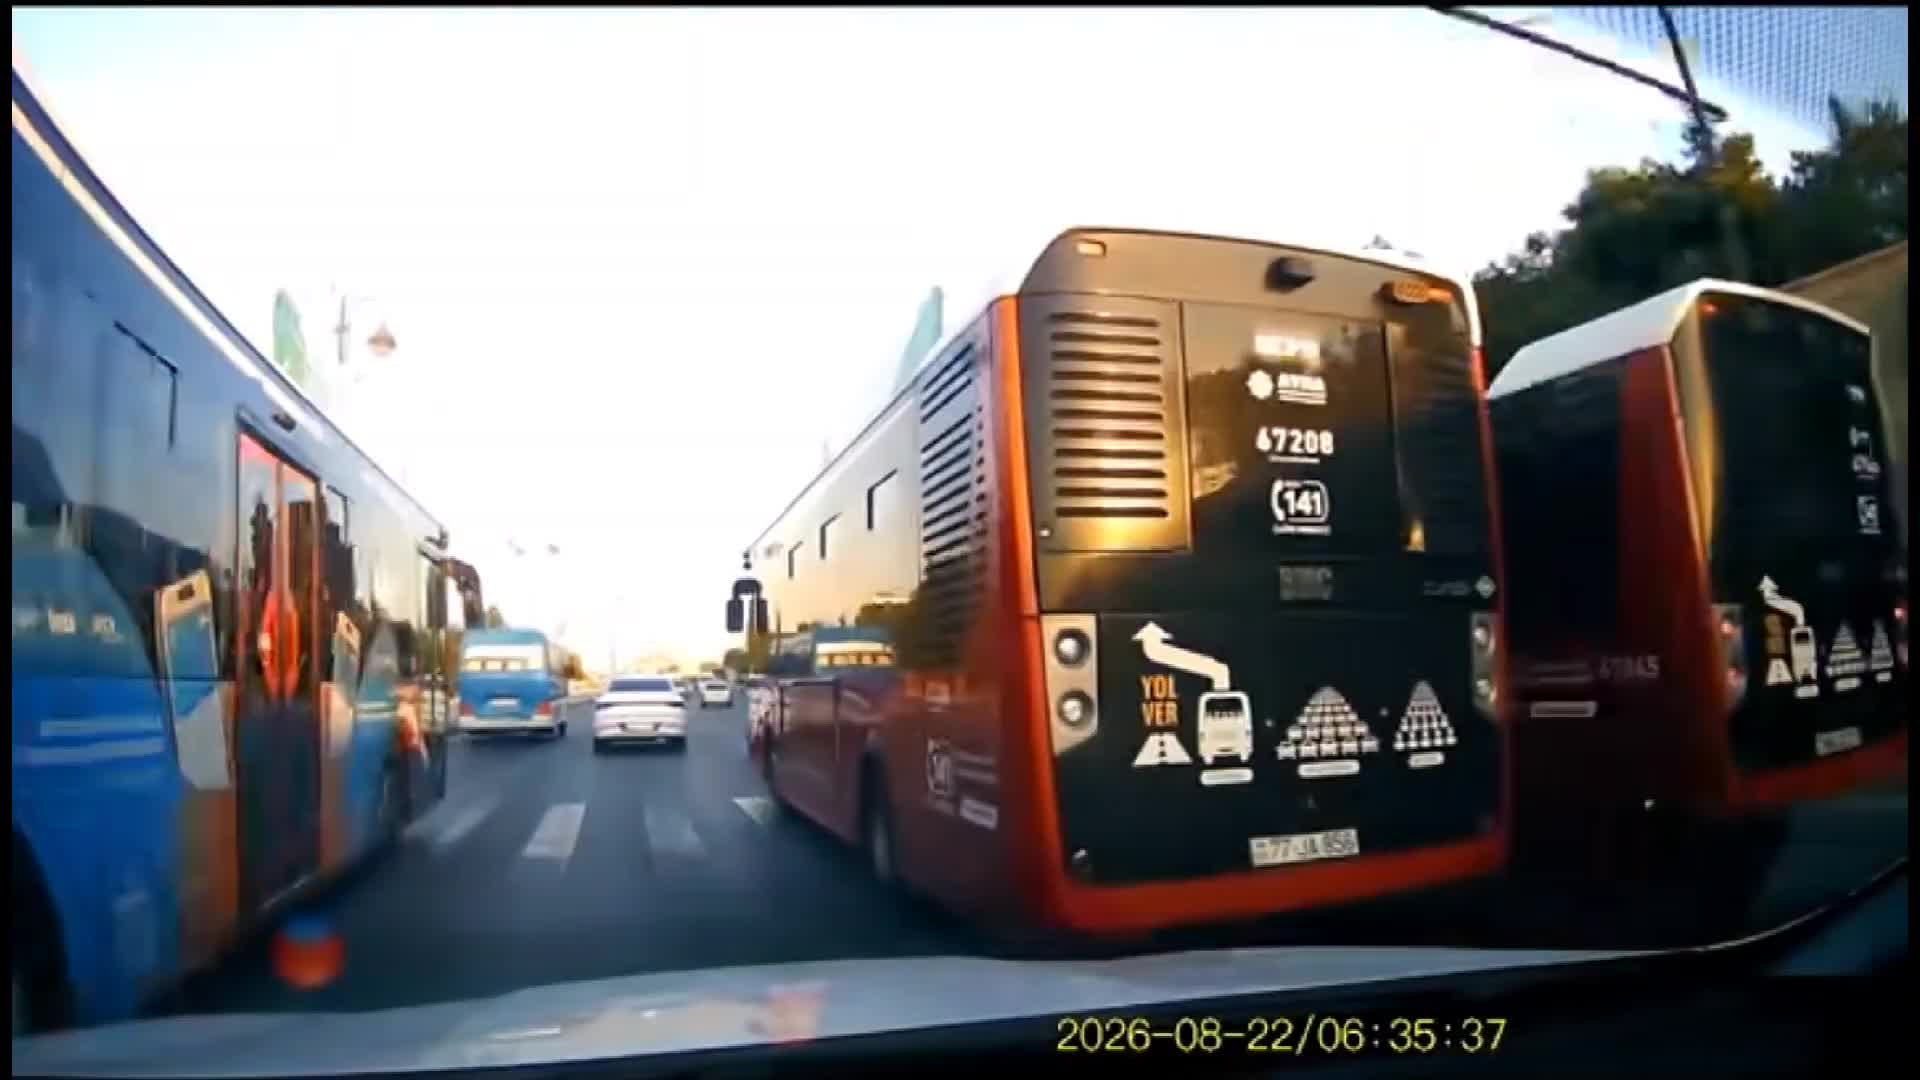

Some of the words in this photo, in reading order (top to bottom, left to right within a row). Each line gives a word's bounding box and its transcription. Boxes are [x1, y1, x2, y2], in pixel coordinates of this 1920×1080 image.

[1256, 427, 1334, 454] 67208
[1284, 489, 1323, 516] 141
[1140, 674, 1178, 699] YOL
[1141, 701, 1178, 727] VER
